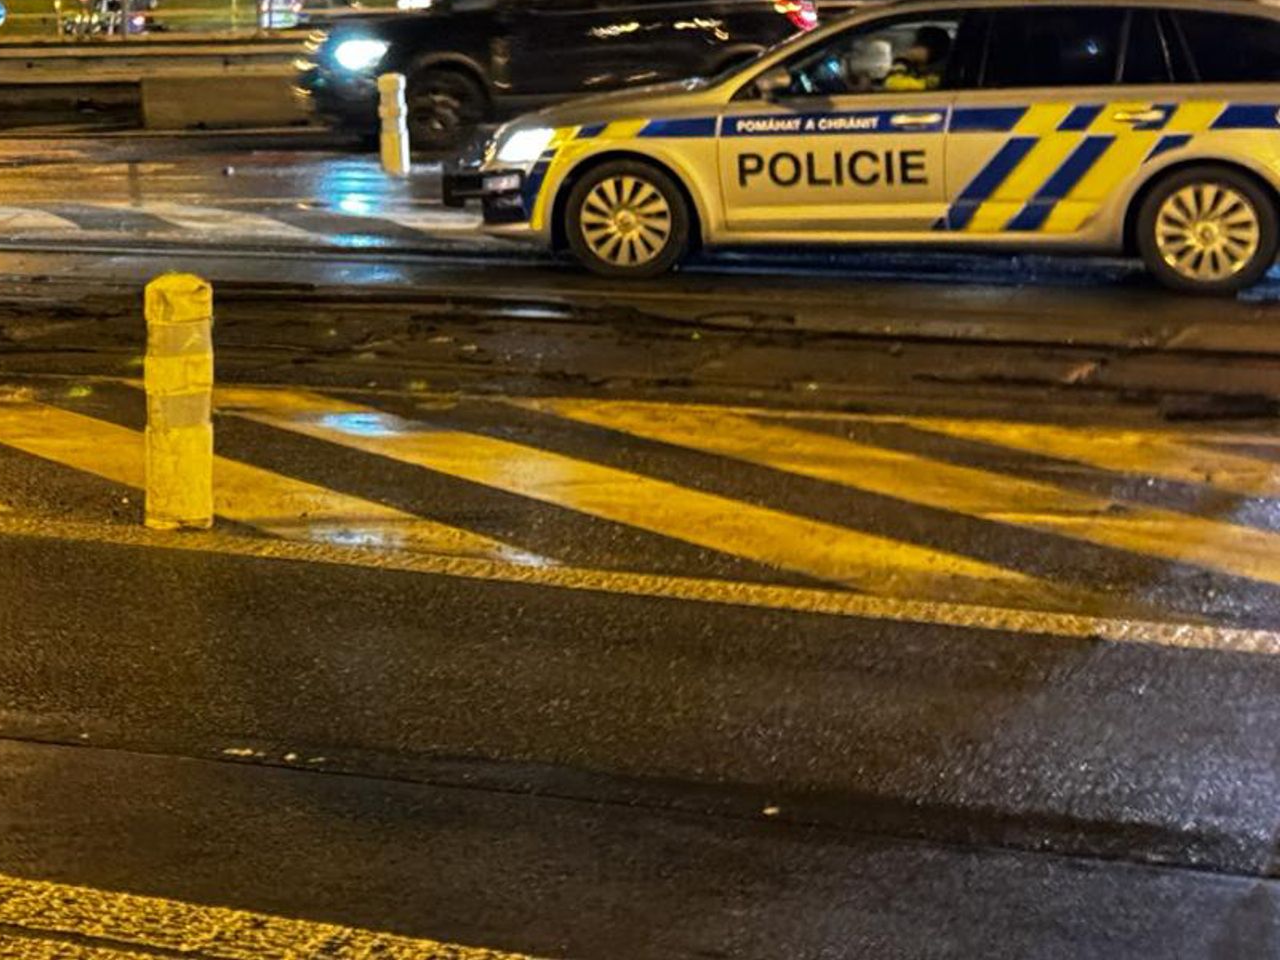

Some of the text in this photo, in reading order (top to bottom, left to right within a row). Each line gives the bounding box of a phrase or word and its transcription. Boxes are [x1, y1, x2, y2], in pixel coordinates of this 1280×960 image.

[736, 117, 801, 132] POMÁHAT
[804, 119, 815, 131] A
[737, 150, 928, 187] POLICIE
